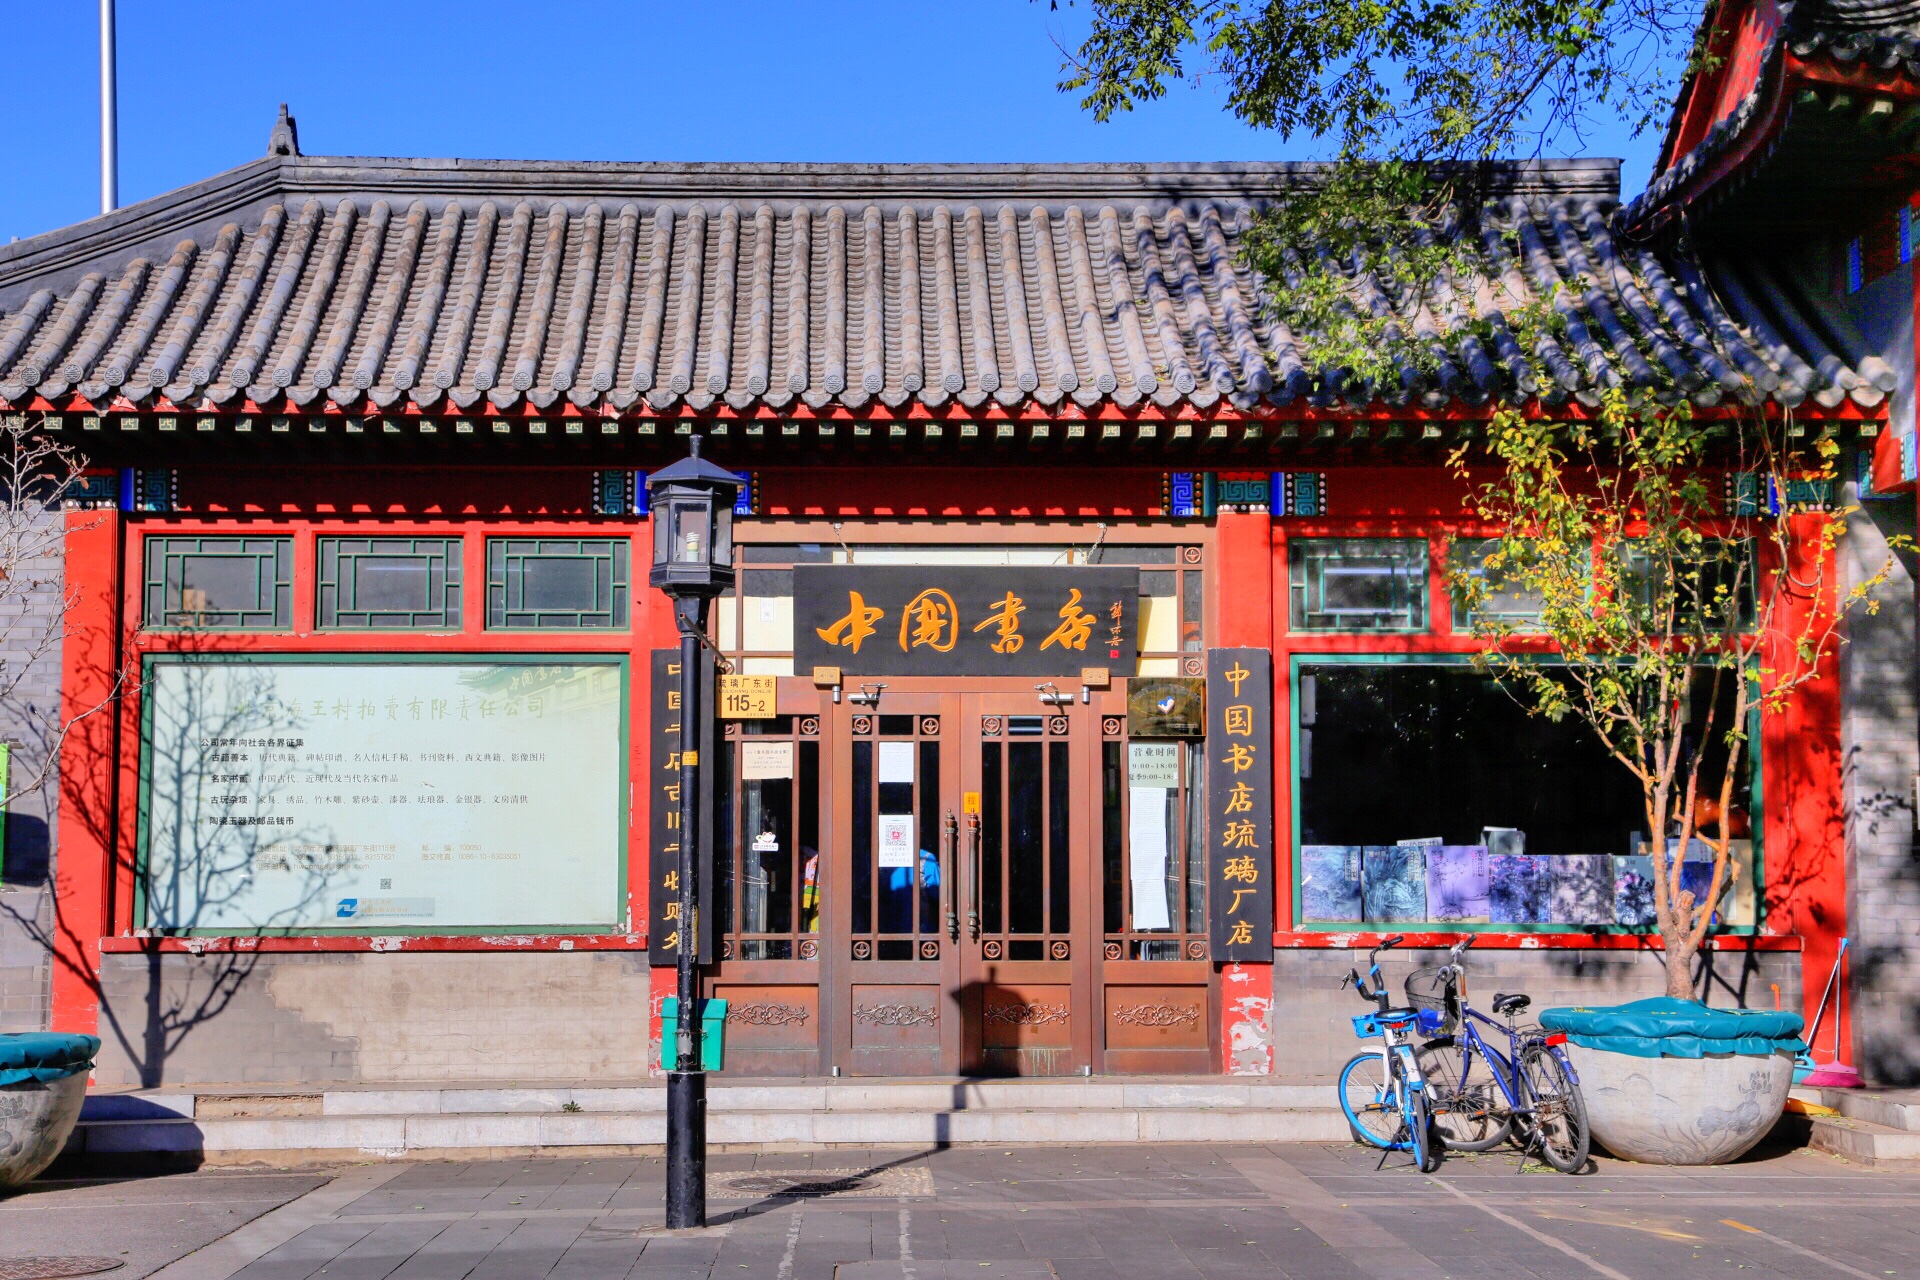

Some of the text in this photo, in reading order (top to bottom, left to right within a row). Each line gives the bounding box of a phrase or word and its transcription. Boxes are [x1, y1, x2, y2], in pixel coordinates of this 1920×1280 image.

[718, 678, 772, 688] 琉璃厂东街
[727, 695, 765, 711] 115-2
[200, 738, 305, 748] 公司常年向社会各界征集
[1134, 748, 1176, 757] 营业时间
[1221, 661, 1259, 946] 中国书店琉璃厂店
[208, 815, 295, 826] 陶瓷玉器及邮品钱币
